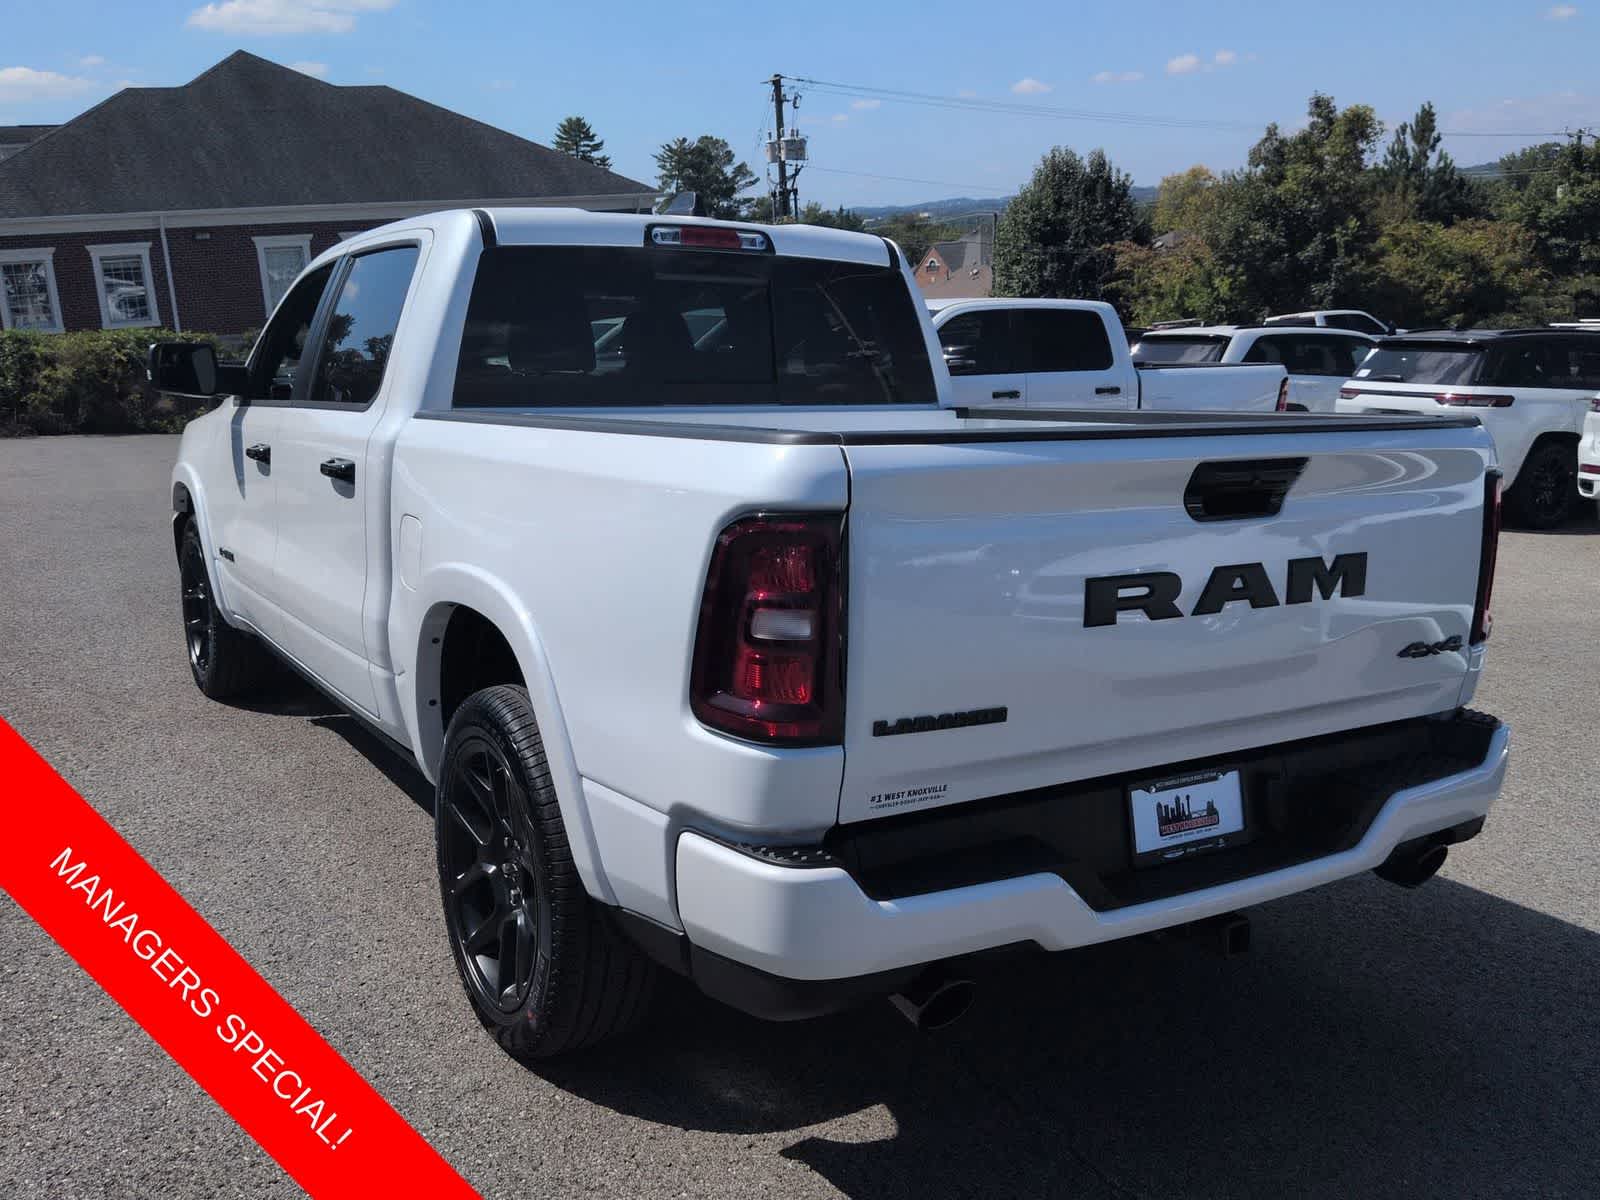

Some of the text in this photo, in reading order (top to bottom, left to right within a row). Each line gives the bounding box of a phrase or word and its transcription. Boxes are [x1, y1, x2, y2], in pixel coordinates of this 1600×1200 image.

[1083, 551, 1367, 628] RAM
[884, 791, 906, 801] WEST
[907, 784, 948, 798] KNOXVILLE
